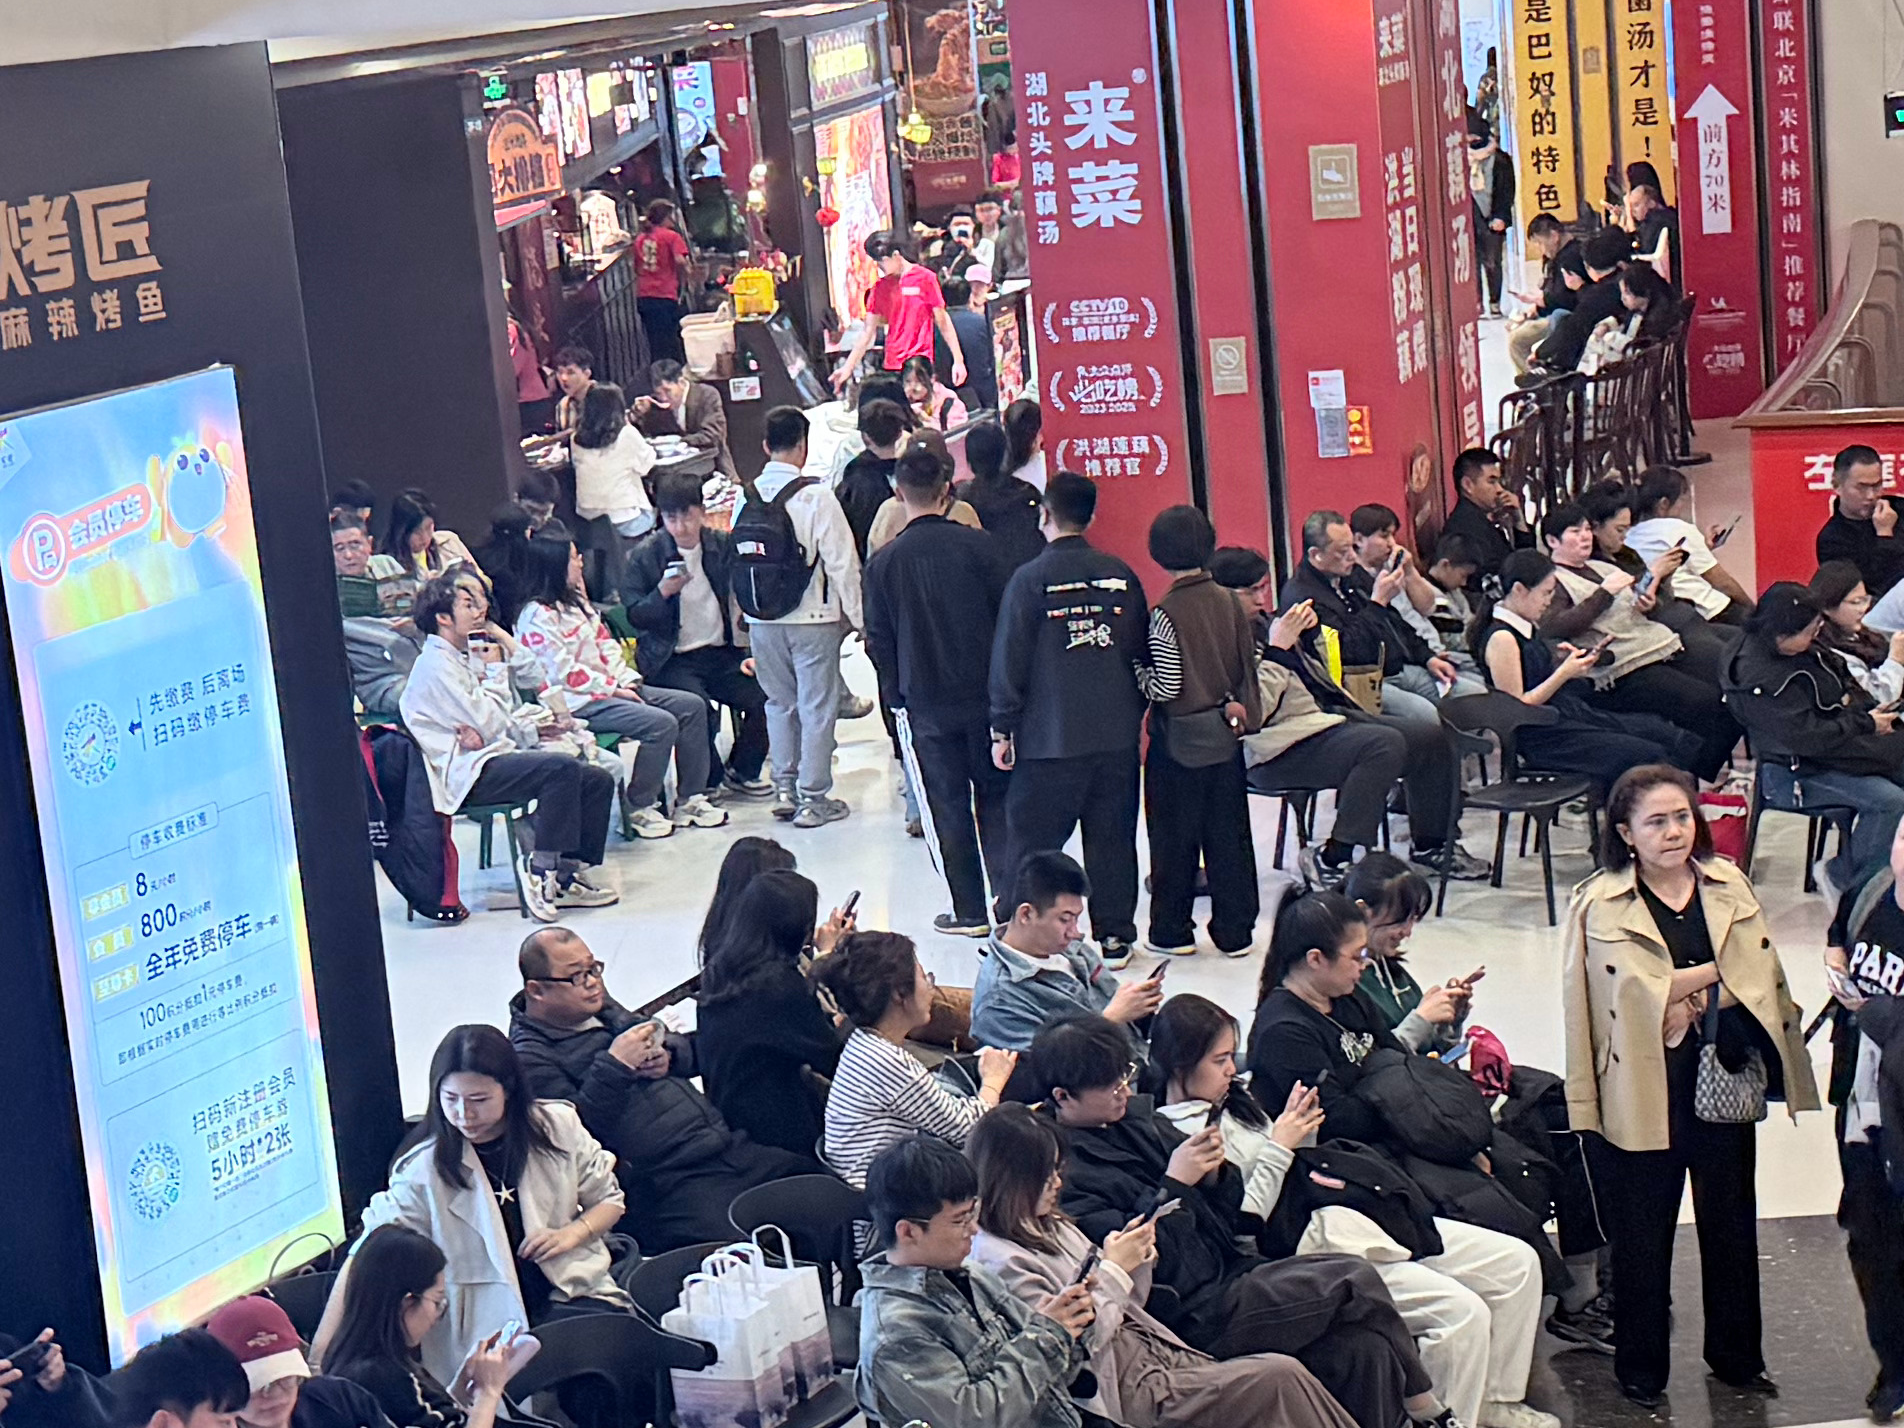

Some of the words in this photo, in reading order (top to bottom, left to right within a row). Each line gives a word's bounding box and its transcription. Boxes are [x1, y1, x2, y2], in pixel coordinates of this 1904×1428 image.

[1024, 71, 1061, 245] 湖北头牌藕汤
[1062, 80, 1142, 229] 来菜
[1702, 123, 1727, 214] 前方70米
[68, 493, 145, 550] 会员停车
[136, 872, 148, 897] 8
[141, 903, 178, 938] 800
[145, 913, 254, 982] 全年免费停车
